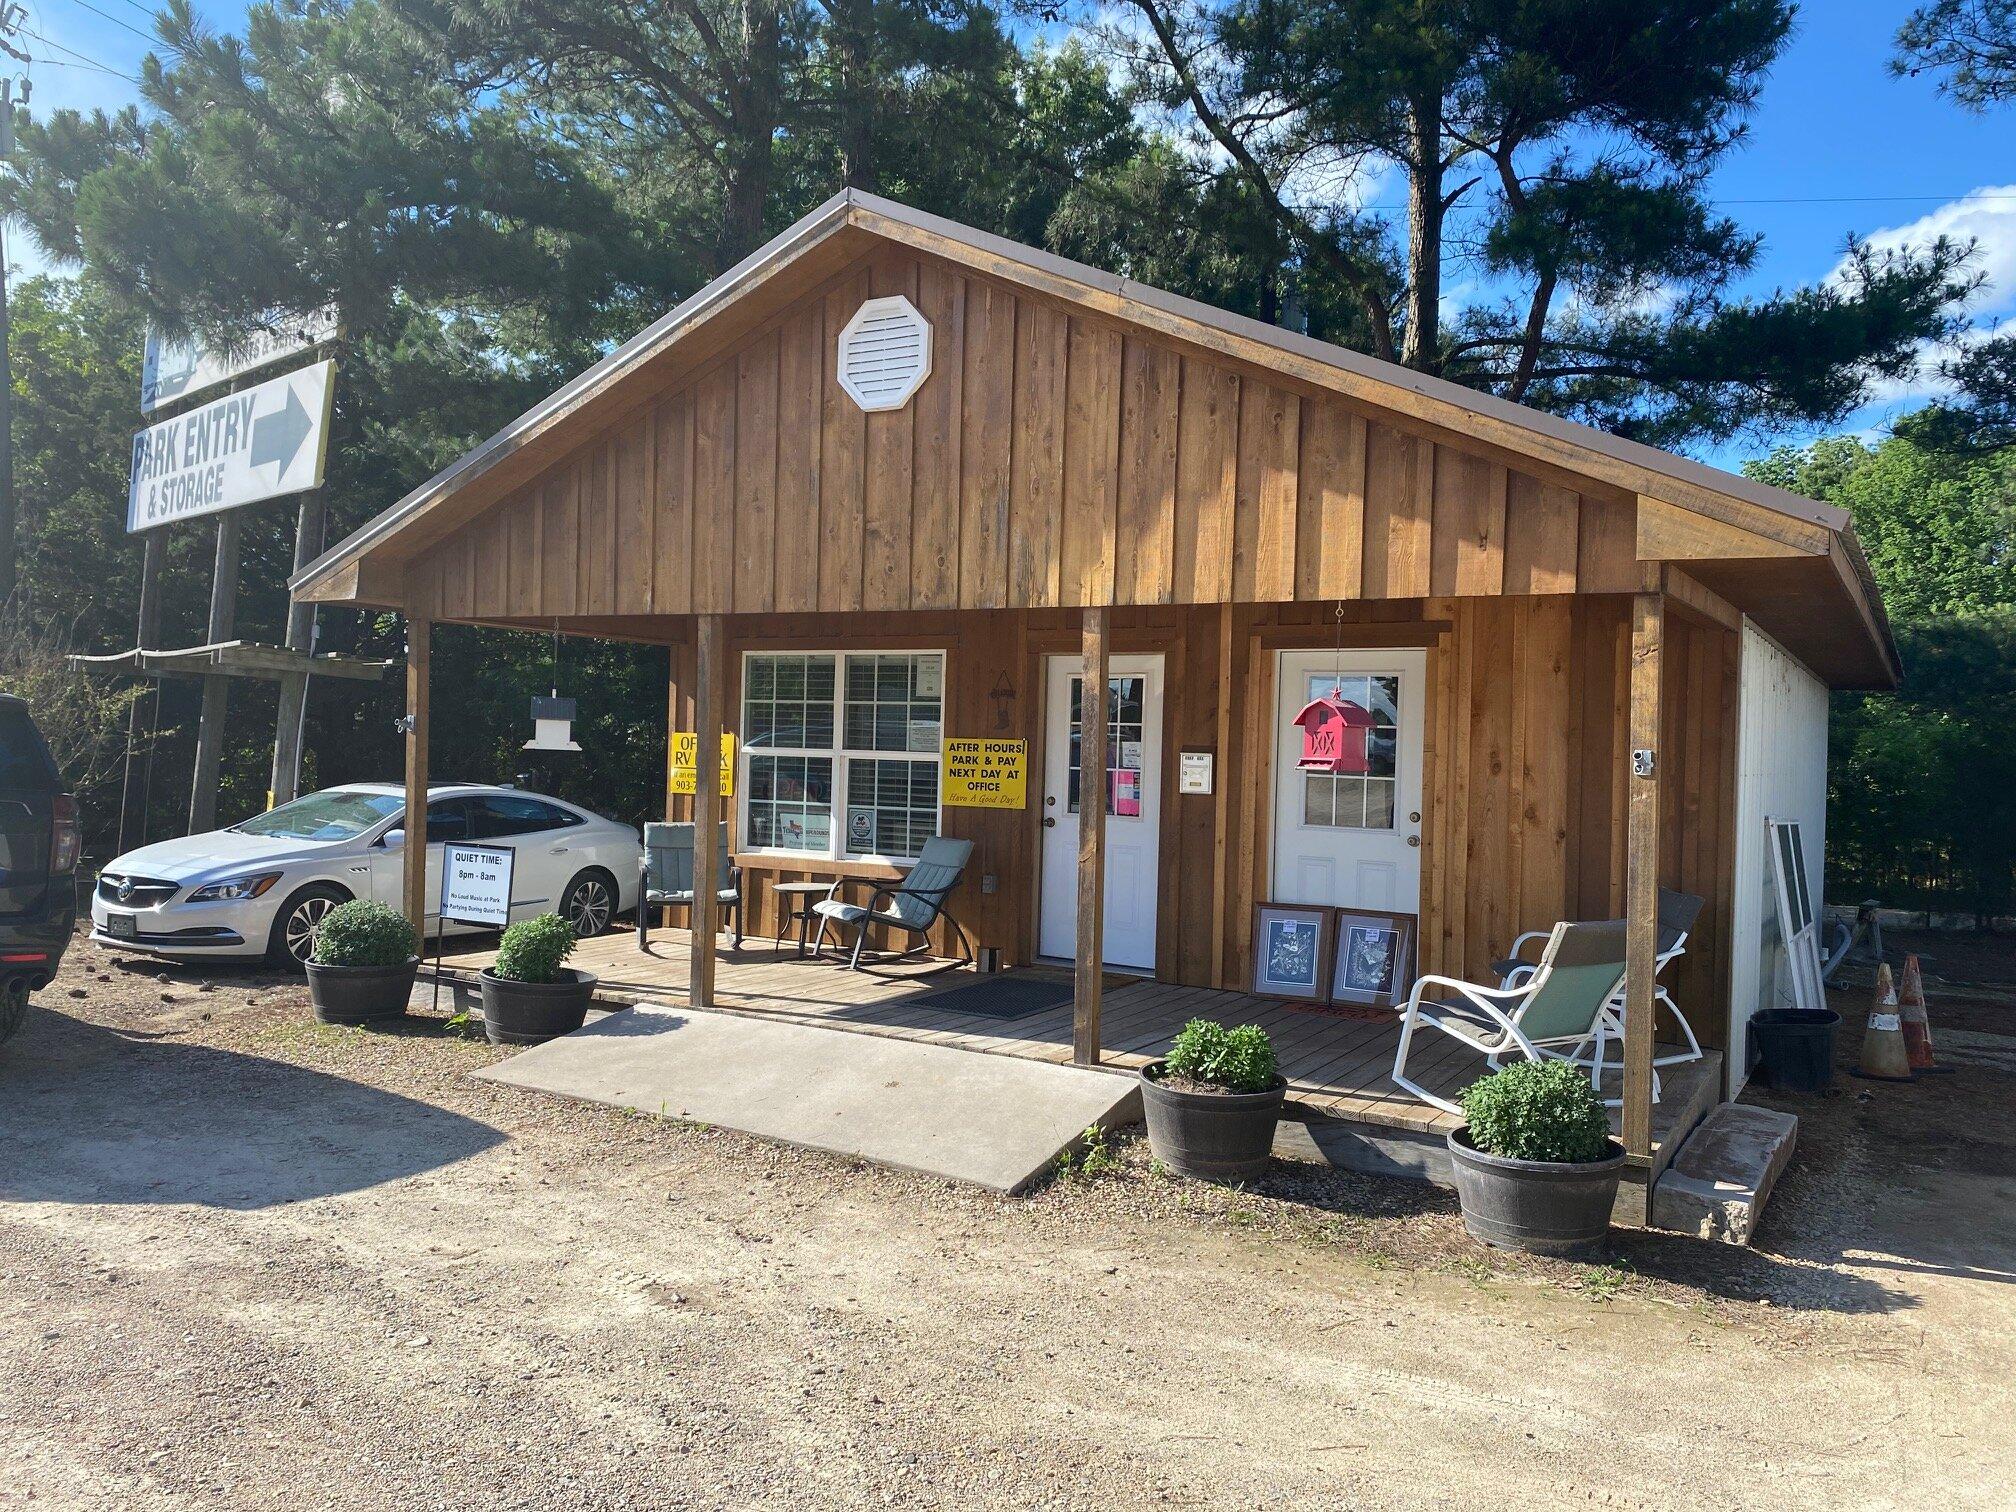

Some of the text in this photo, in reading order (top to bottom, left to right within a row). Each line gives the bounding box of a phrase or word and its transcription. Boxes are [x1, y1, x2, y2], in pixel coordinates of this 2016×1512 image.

[132, 393, 257, 484] PARK ENTRY
[147, 464, 225, 520] & STORAGE
[949, 743, 1022, 753] AFTER HOURS
[675, 751, 691, 765] RV
[952, 755, 1017, 766] PARK & PAY
[949, 769, 1019, 779] NEXT DAY AT
[967, 782, 1000, 791] OFFICE
[949, 793, 967, 802] Have
[970, 794, 976, 802] A
[979, 794, 997, 803] Good
[455, 852, 502, 865] QUIET TIME:
[458, 869, 474, 880] 8pm
[480, 871, 496, 882] 8am
[470, 894, 482, 902] Music
[449, 903, 467, 912] Partying
[468, 905, 483, 914] During
